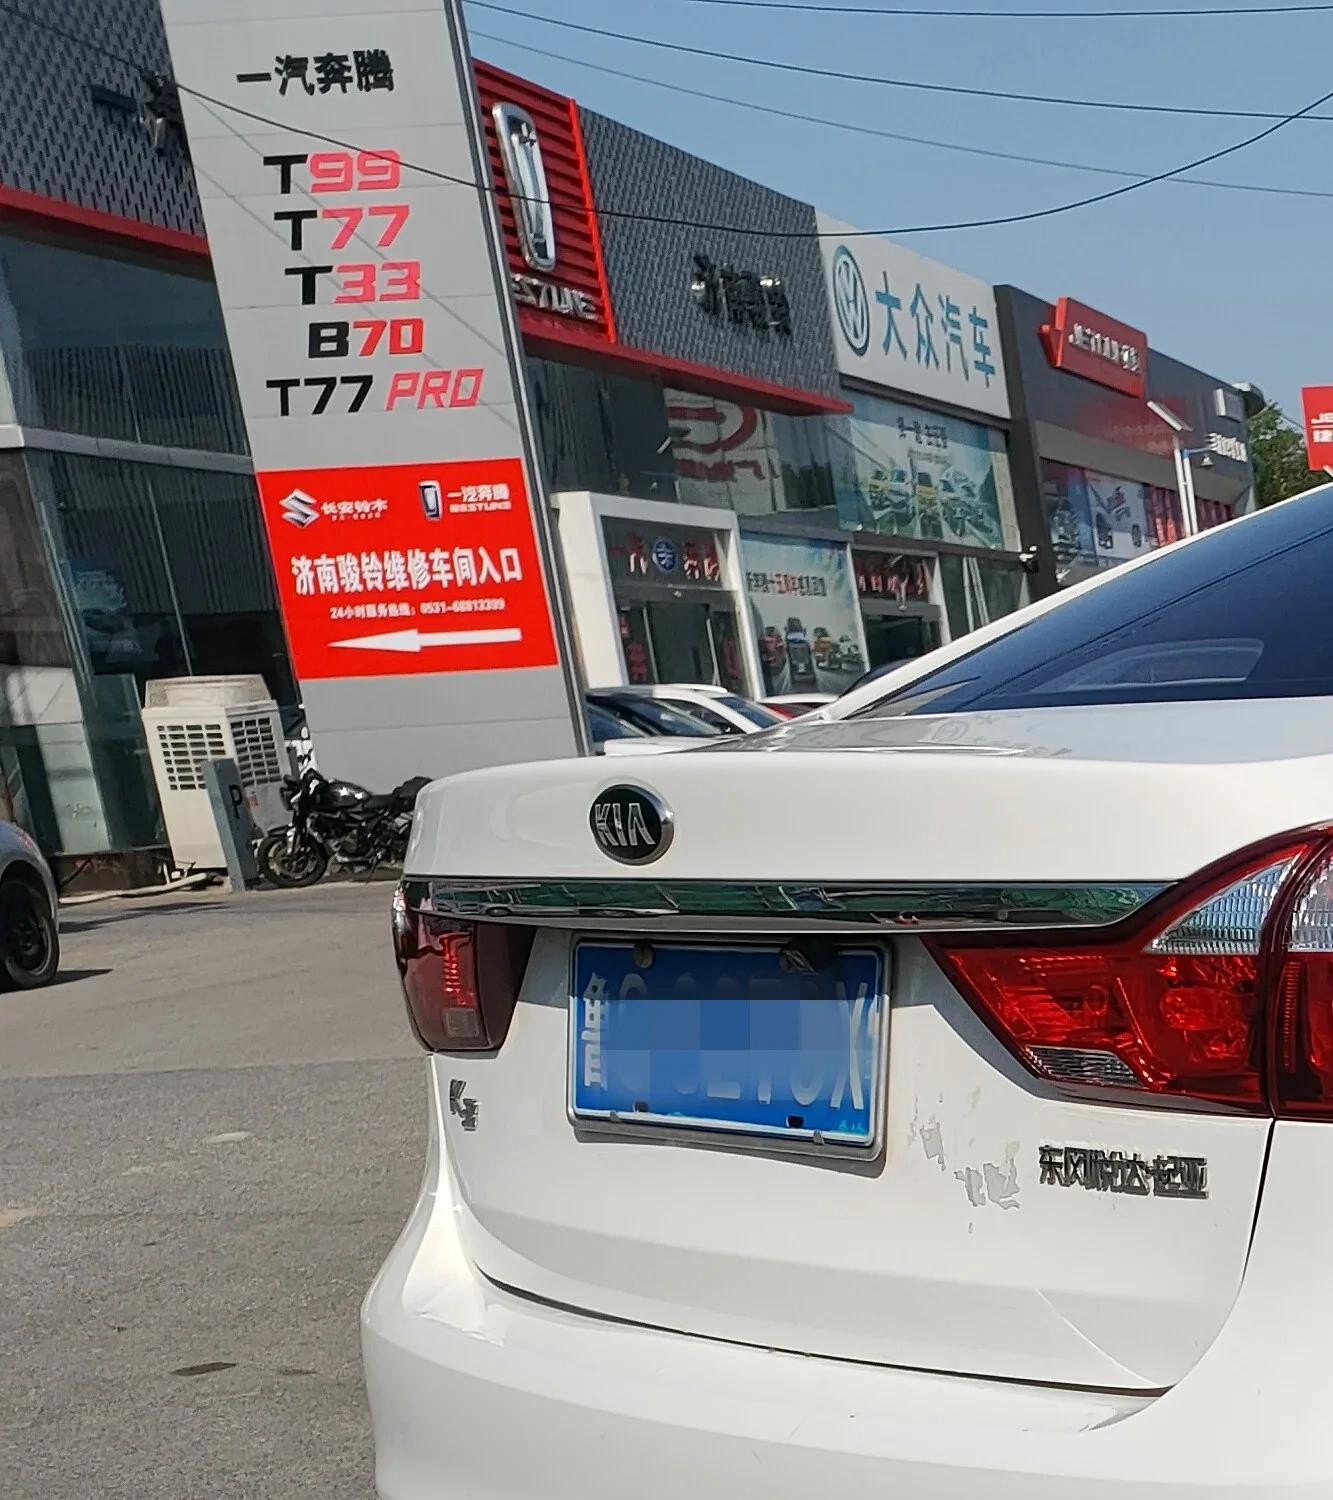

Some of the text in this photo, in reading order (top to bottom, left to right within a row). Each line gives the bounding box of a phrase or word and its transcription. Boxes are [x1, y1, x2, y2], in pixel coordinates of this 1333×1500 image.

[236, 50, 396, 95] 一汽奔腾
[262, 149, 402, 194] T99
[273, 205, 410, 251] T77
[284, 260, 421, 306] T33
[308, 318, 424, 359] B70
[875, 270, 997, 388] 大众汽车
[266, 368, 485, 418] T77 PRO
[291, 546, 523, 596] 济南骏铃维修车间入口
[595, 802, 657, 847] KIA
